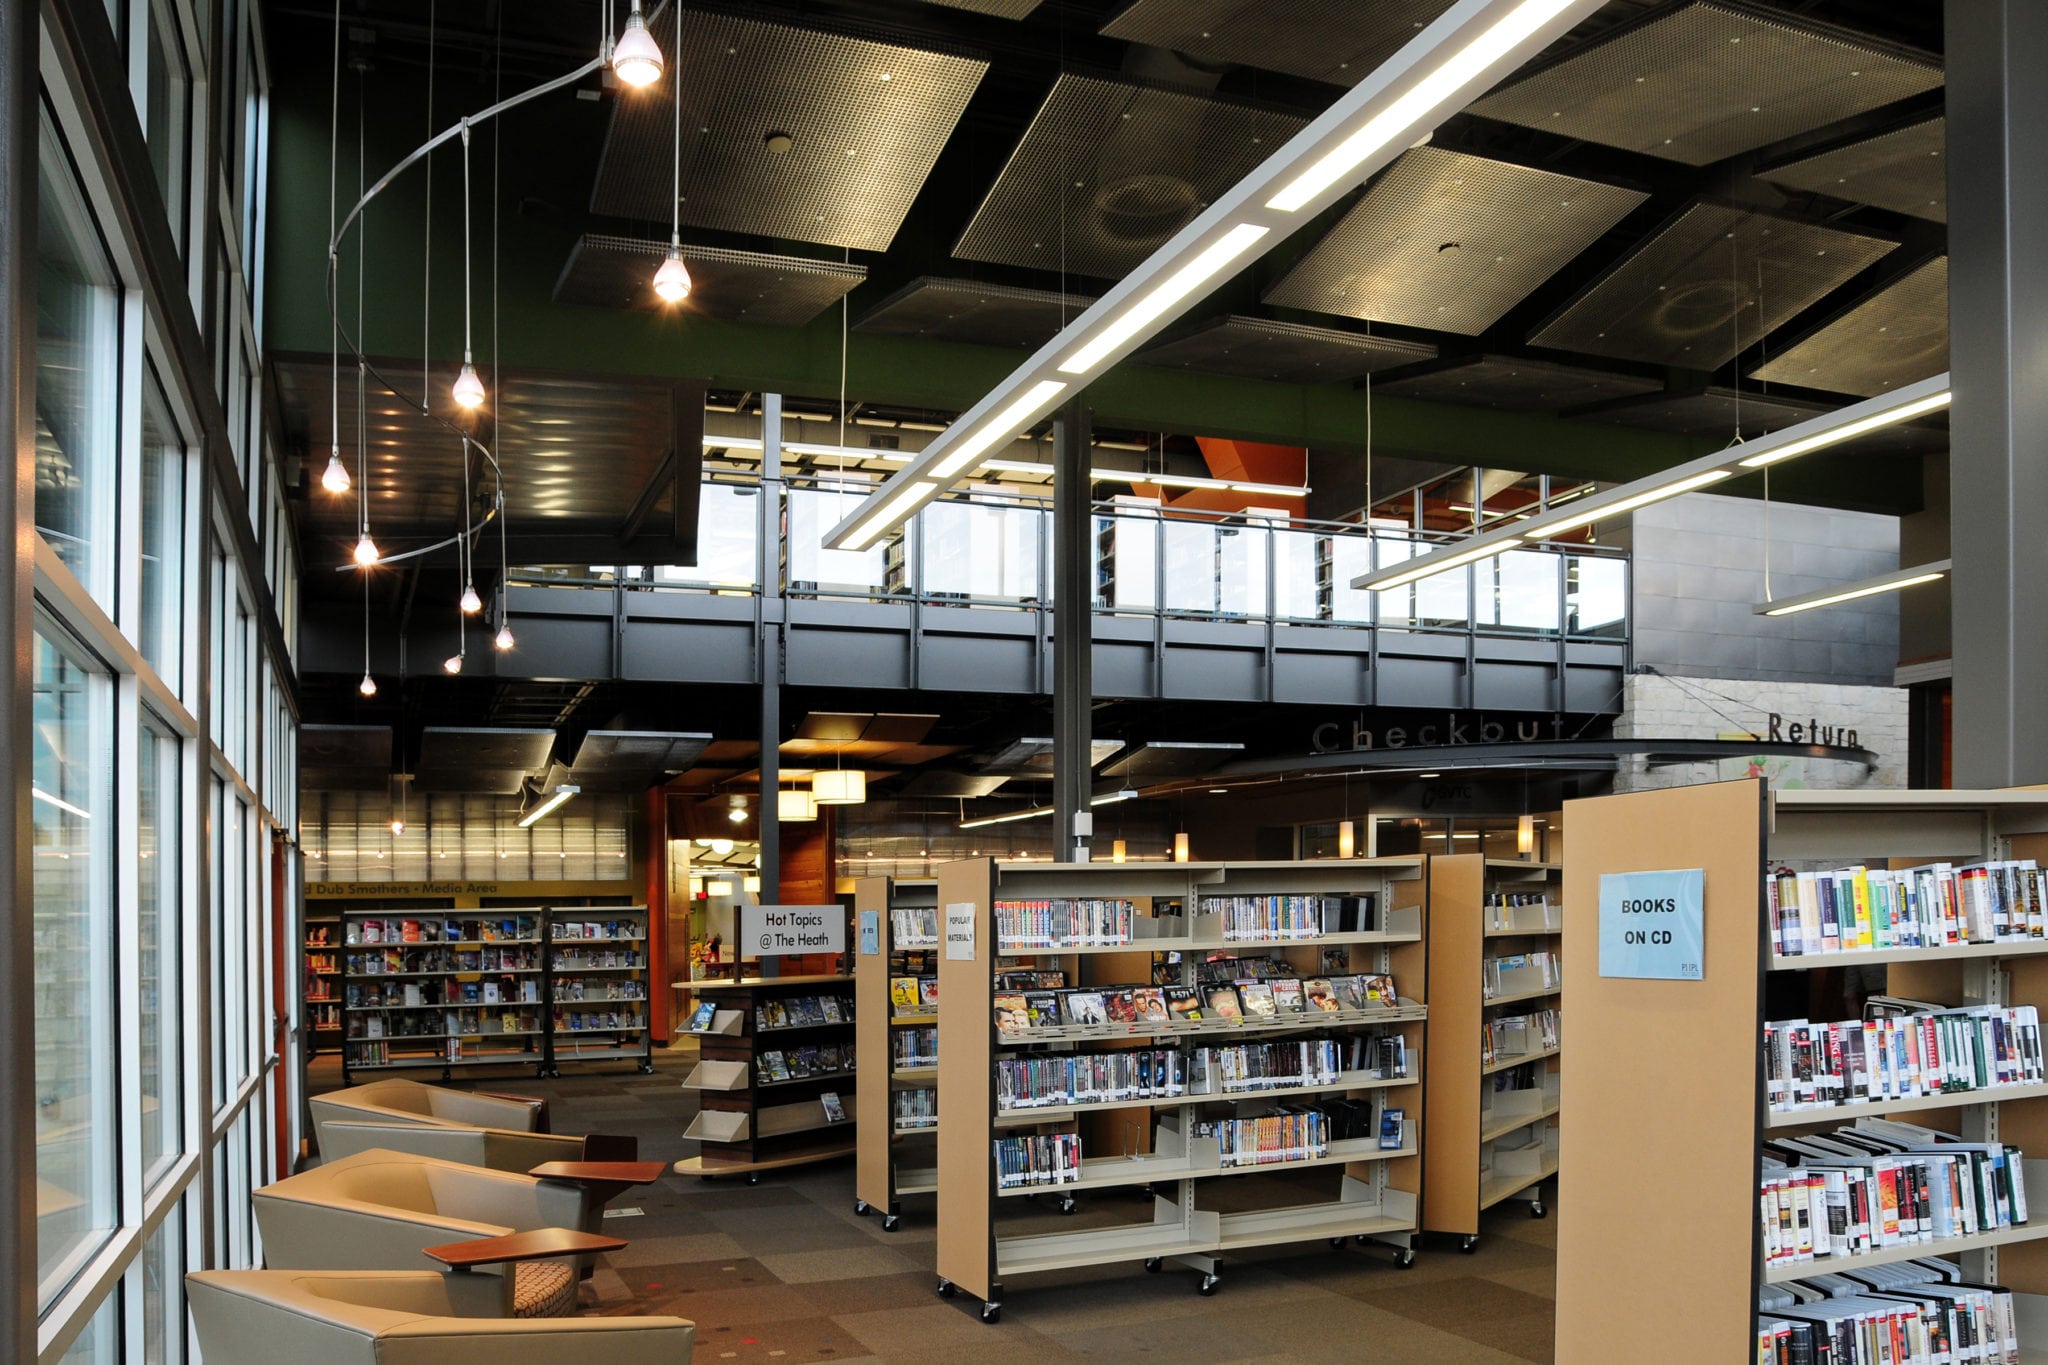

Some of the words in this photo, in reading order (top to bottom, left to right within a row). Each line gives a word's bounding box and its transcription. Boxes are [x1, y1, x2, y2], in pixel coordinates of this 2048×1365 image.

[1312, 713, 1564, 750] Checkout
[1769, 712, 1857, 748] Return
[316, 884, 344, 895] Dub
[348, 883, 410, 895] Smothers
[422, 883, 462, 894] Media
[467, 883, 497, 894] Area
[1621, 898, 1676, 914] BOOKS
[765, 912, 787, 926] Hot
[790, 912, 823, 929] Topics
[759, 933, 772, 950] @
[775, 933, 795, 947] The
[797, 932, 829, 947] Heath
[1624, 930, 1646, 945] ON
[1651, 930, 1672, 945] CD
